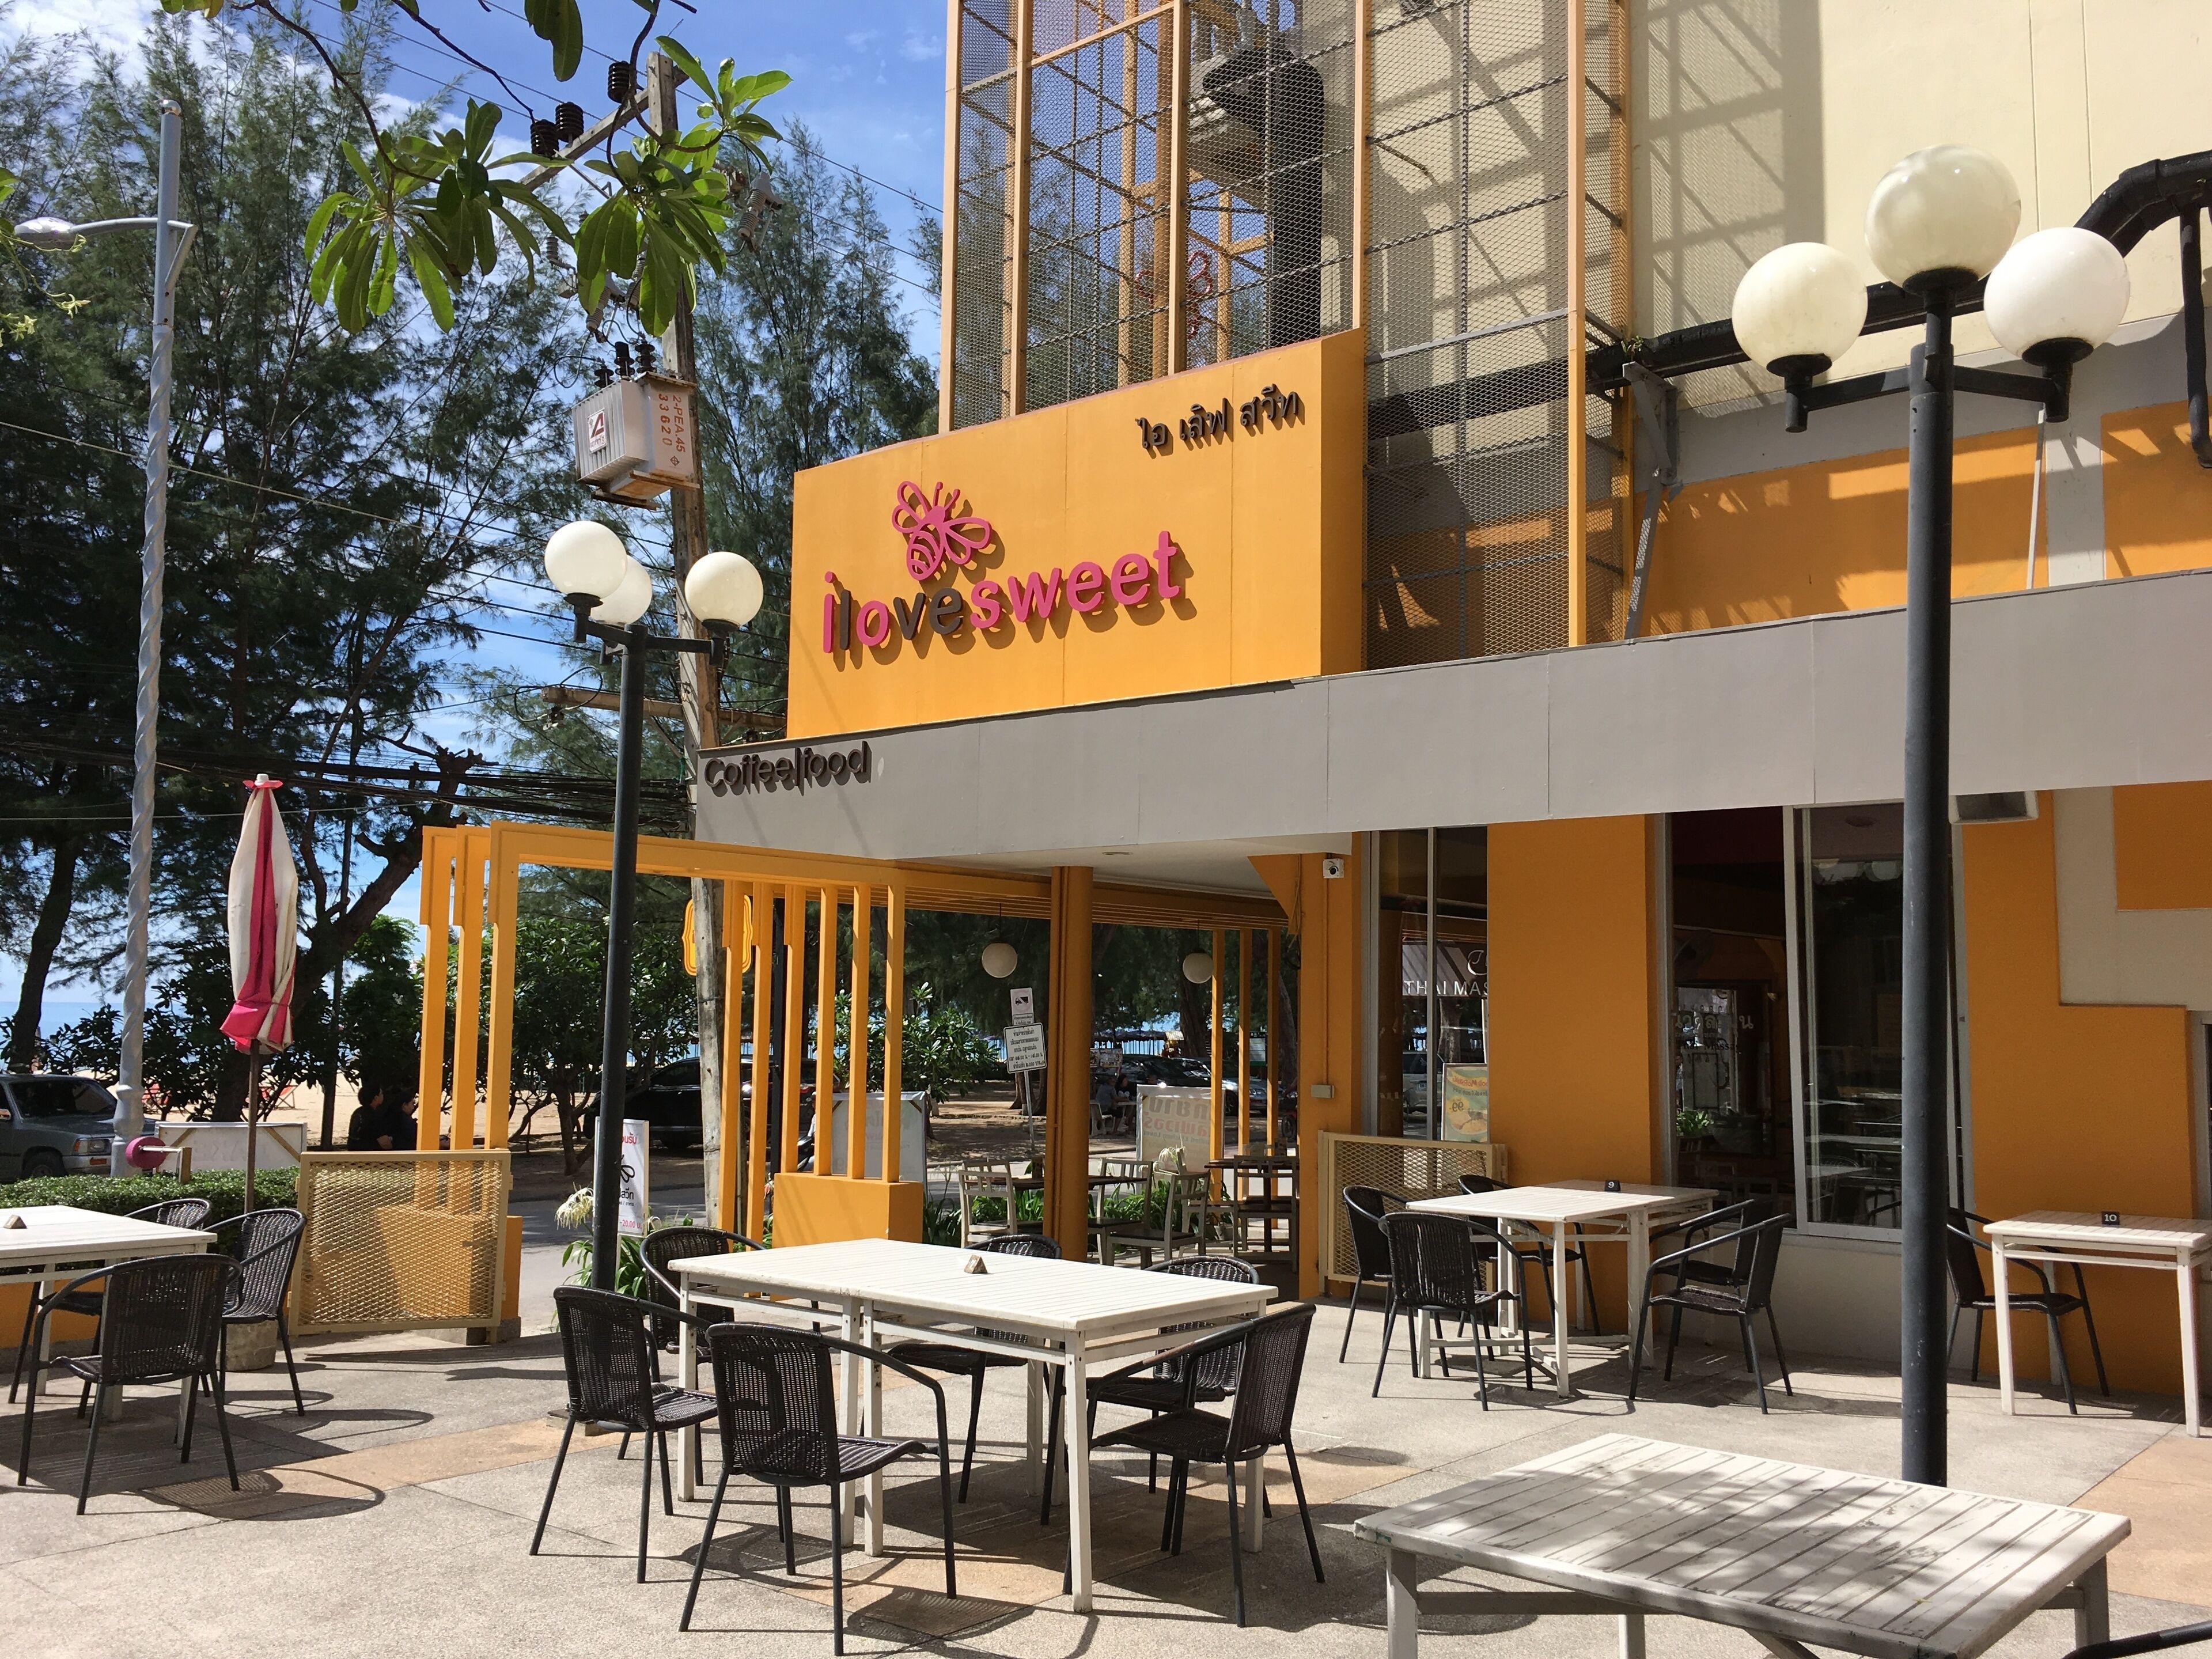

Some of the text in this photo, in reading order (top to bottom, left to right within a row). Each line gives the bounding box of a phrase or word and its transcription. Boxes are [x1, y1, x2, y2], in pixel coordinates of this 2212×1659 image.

[1135, 383, 1300, 449] ไอ เลิฟ สวีท
[2104, 1214, 2118, 1222] 10
